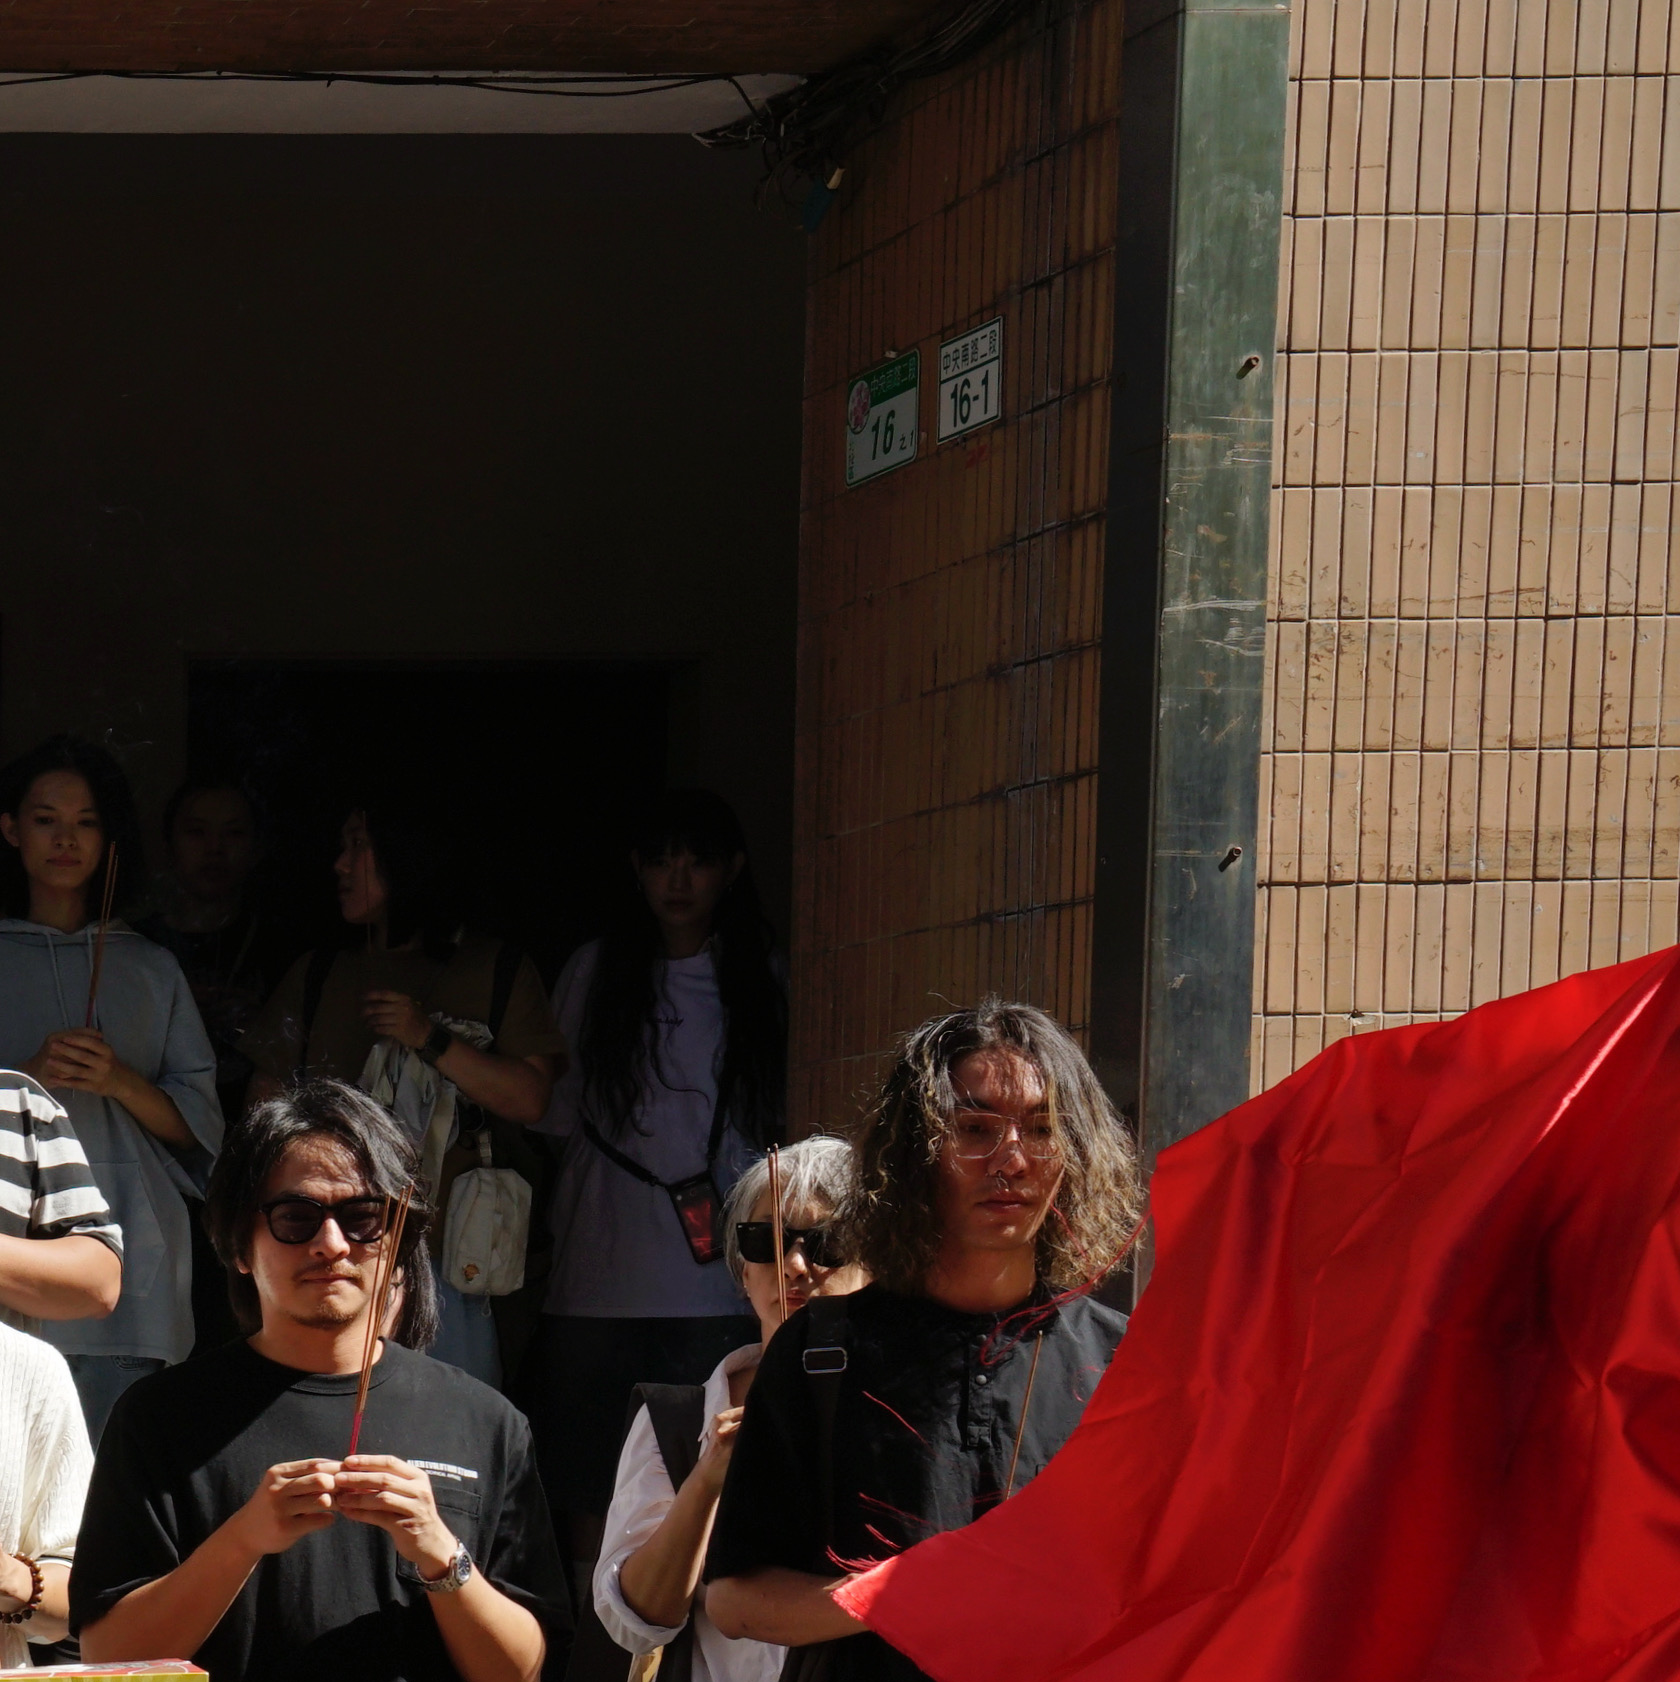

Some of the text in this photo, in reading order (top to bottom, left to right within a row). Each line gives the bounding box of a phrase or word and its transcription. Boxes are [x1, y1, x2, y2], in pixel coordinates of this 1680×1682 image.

[943, 329, 996, 374] 中央南路二段
[951, 370, 989, 428] 16-1
[872, 410, 895, 460] 16
